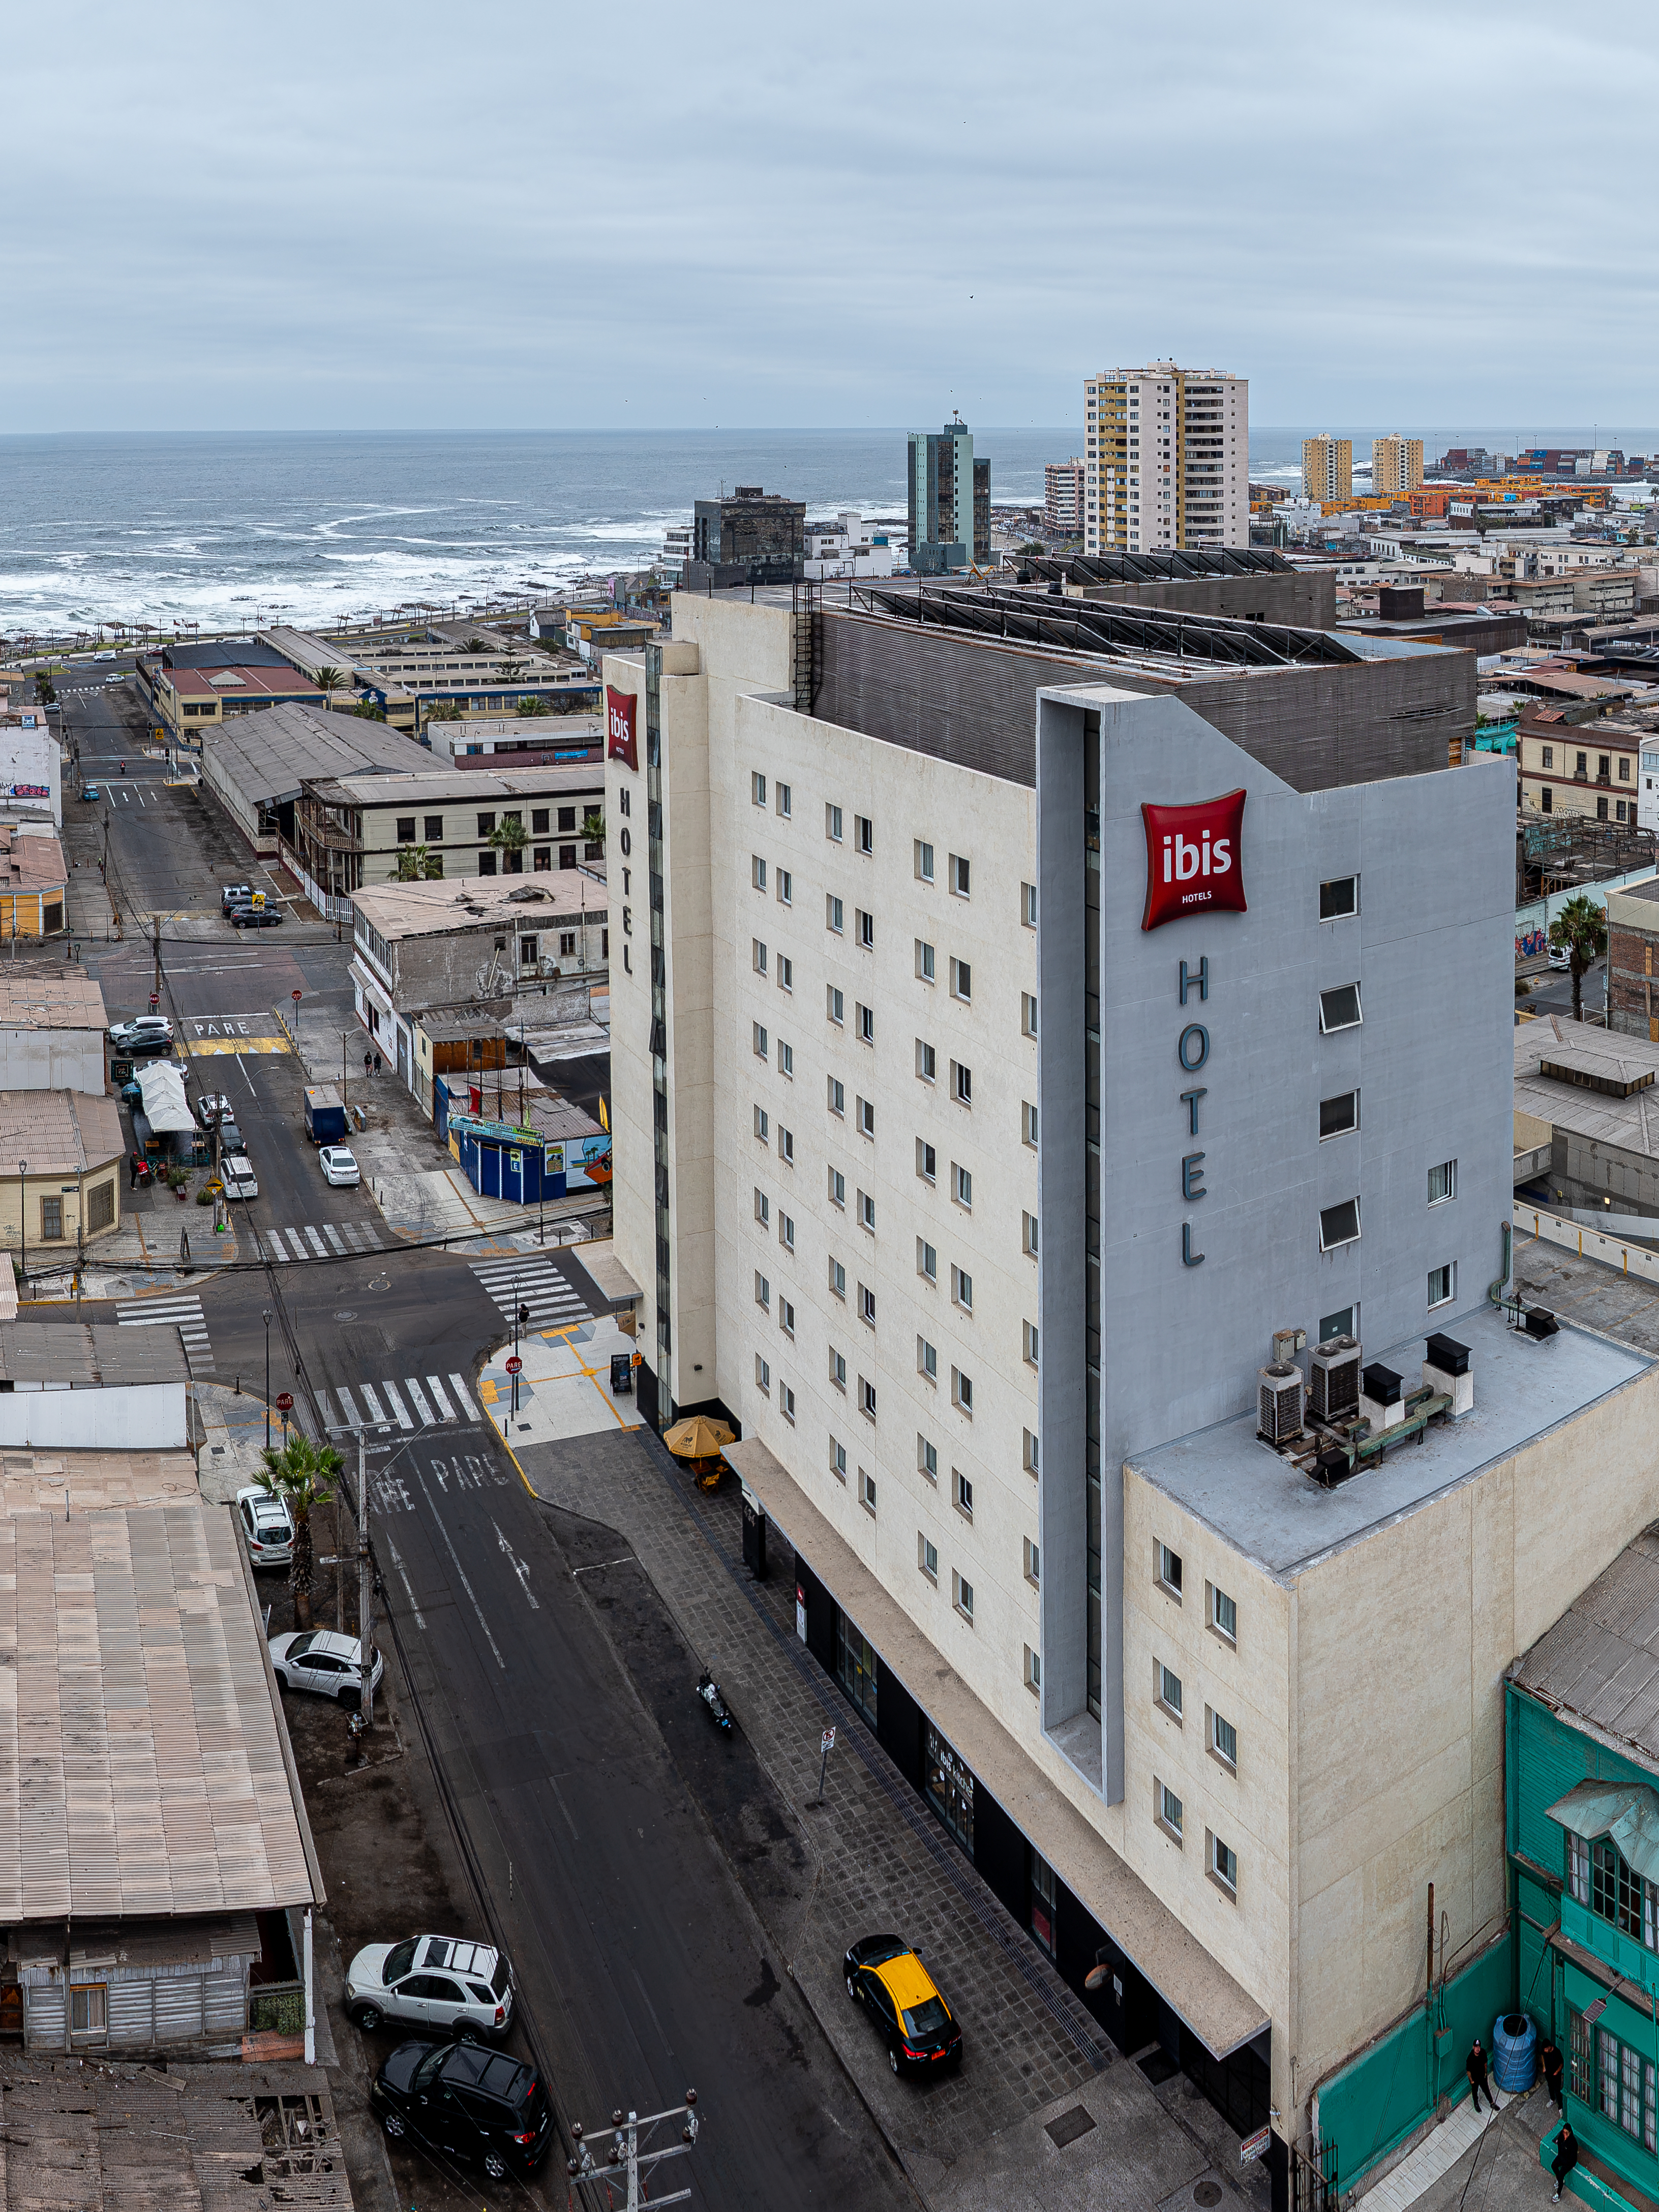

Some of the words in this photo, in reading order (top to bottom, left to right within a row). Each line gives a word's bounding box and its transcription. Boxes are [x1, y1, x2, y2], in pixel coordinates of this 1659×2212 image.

[611, 707, 628, 741] ibis
[1163, 829, 1231, 883] ibis
[619, 787, 632, 975] HOTEL
[1182, 891, 1212, 903] HOTELS
[194, 1022, 250, 1036] PARE
[1178, 956, 1210, 1266] HOTEL
[430, 1453, 509, 1492] PARE
[941, 1749, 952, 1772] ibis
